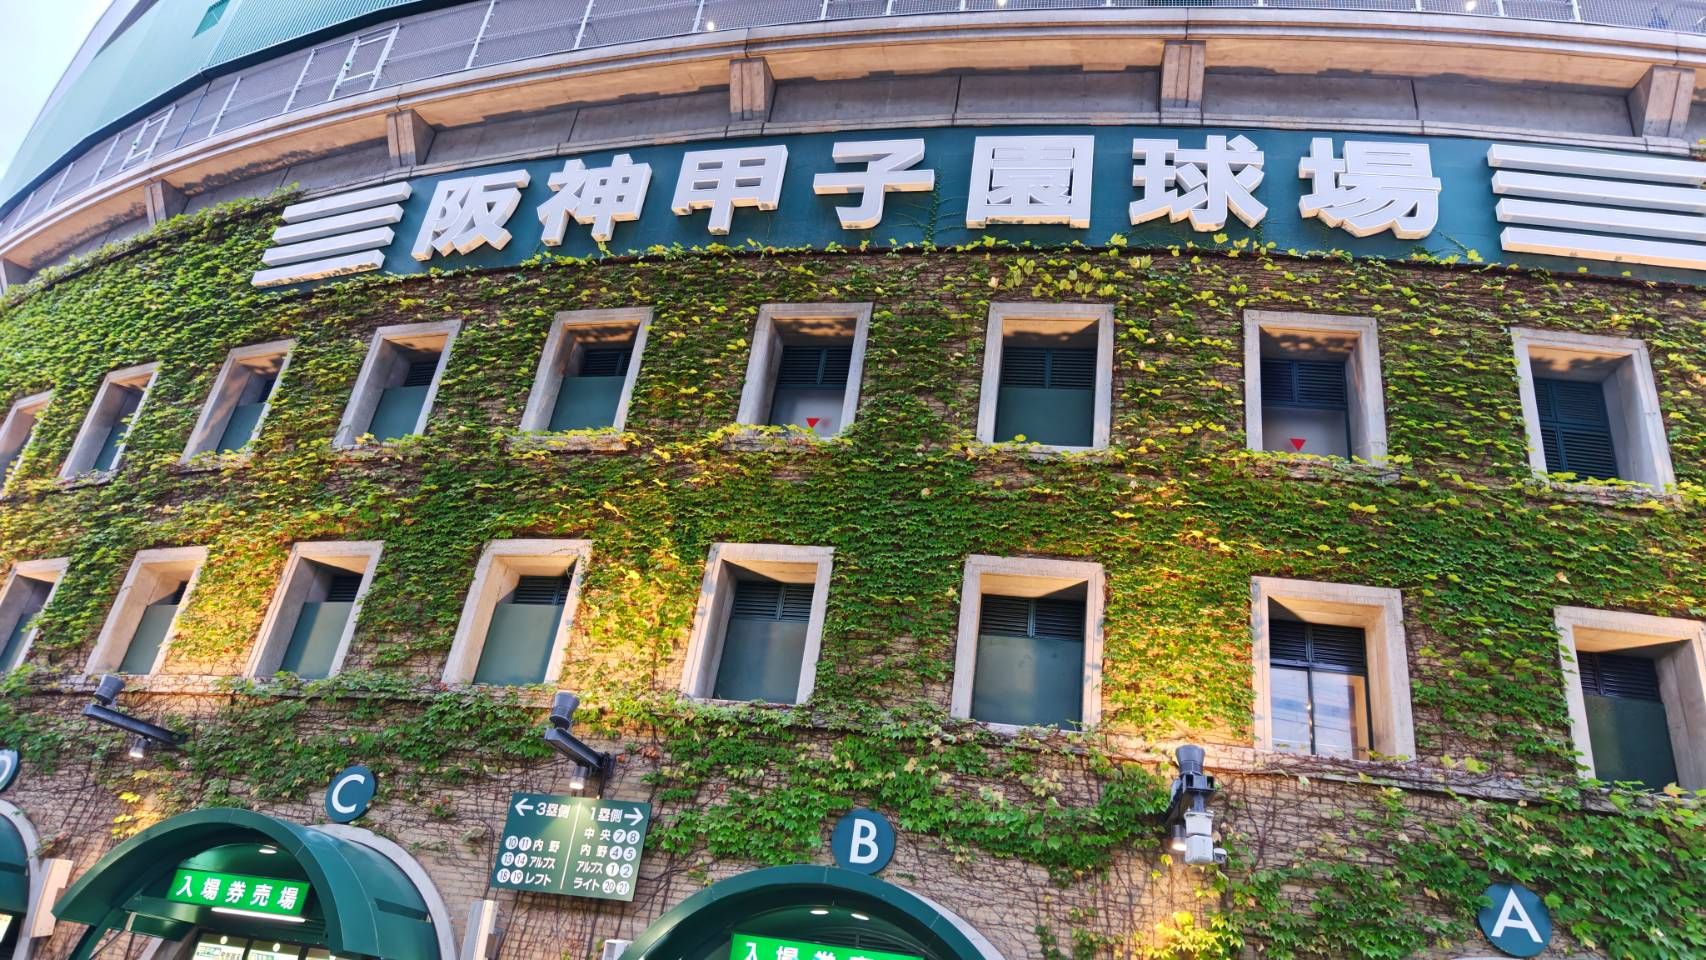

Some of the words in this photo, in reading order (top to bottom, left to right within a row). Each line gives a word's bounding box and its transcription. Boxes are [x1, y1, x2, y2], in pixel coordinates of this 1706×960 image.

[411, 134, 1441, 262] 阪神甲子園球場
[331, 773, 366, 813] C
[536, 802, 571, 818] 3塁側
[590, 806, 623, 823] 1塁側
[849, 818, 879, 865] B
[176, 875, 300, 910] 入場券売場
[525, 872, 552, 886] レフト
[573, 877, 600, 892] ライト
[1491, 887, 1543, 943] A
